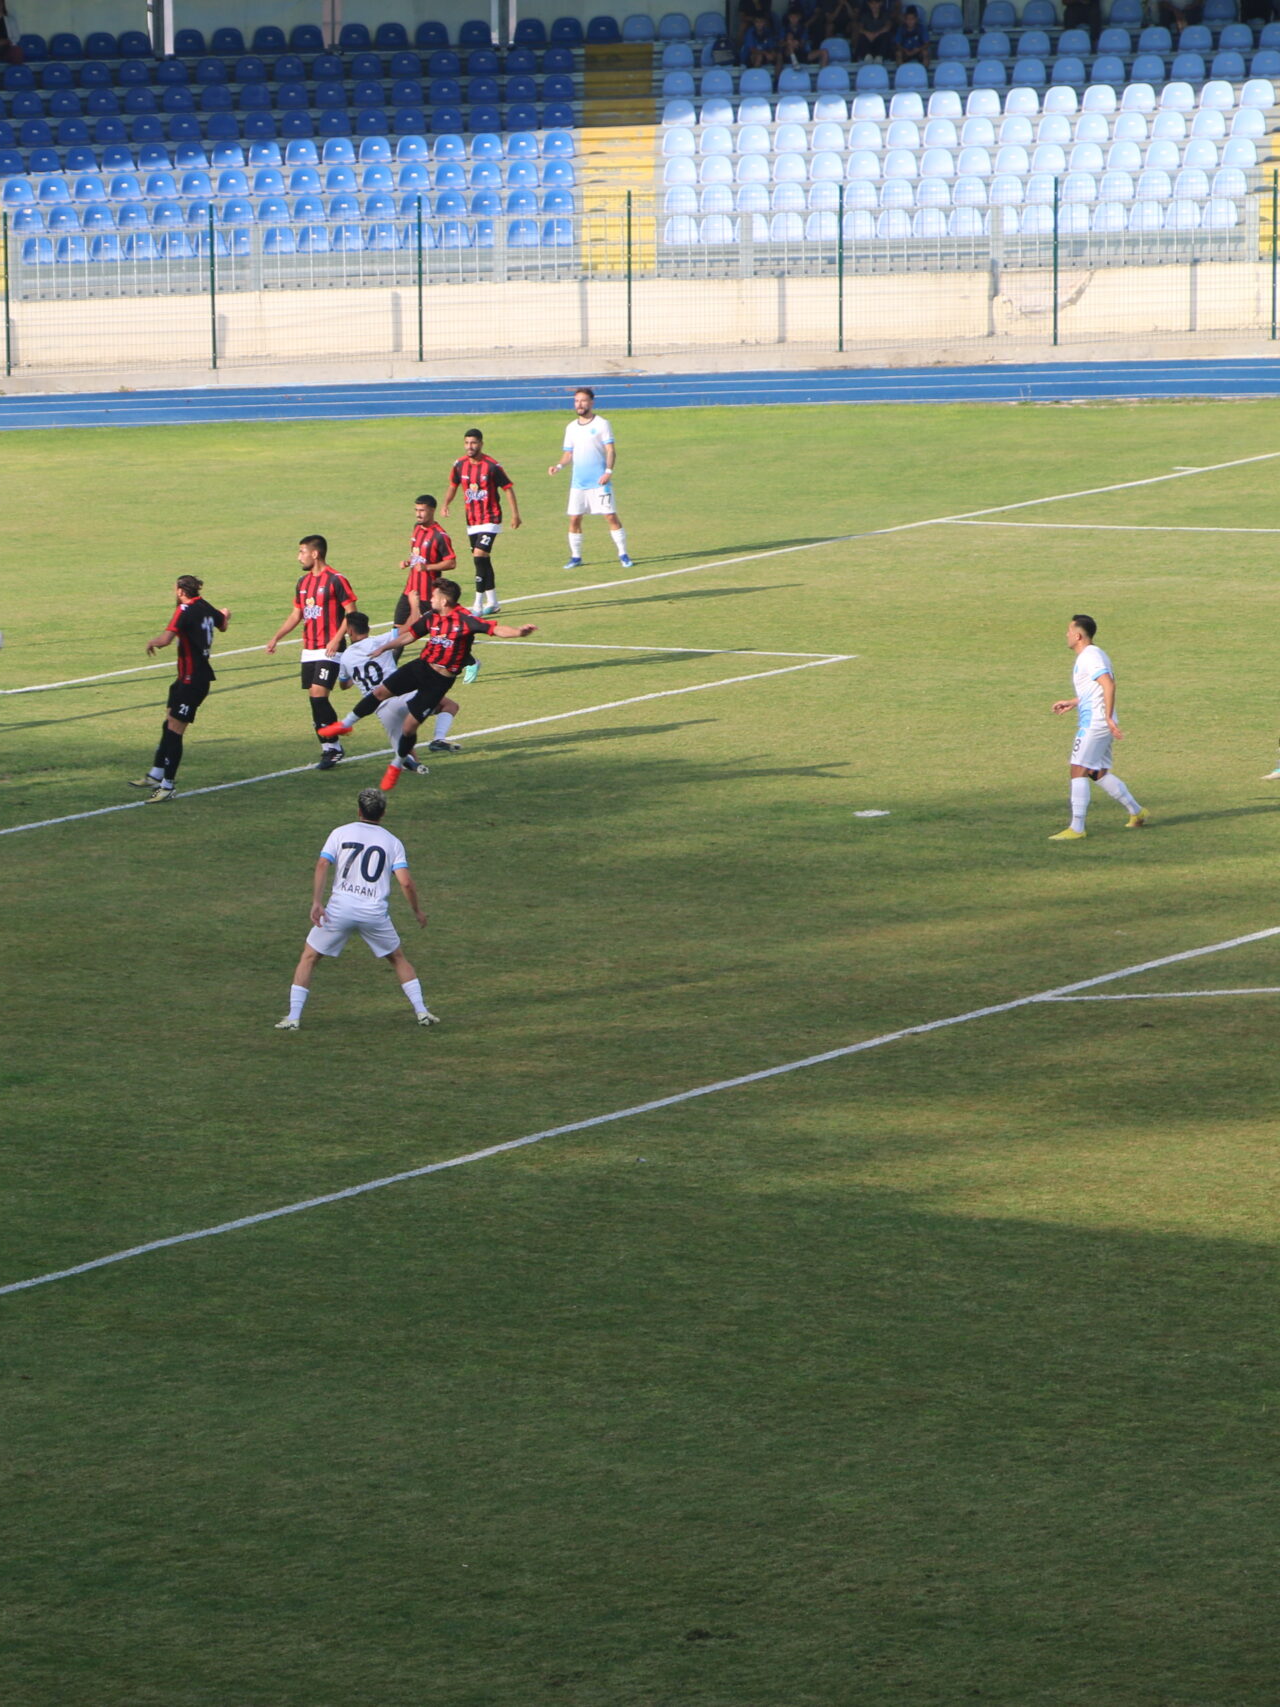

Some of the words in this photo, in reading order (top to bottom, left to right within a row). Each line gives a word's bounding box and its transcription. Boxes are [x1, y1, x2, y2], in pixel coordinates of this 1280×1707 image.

[599, 494, 612, 505] 77
[319, 667, 329, 680] 31
[353, 661, 383, 691] 10
[179, 704, 189, 715] 21
[341, 842, 386, 883] 70
